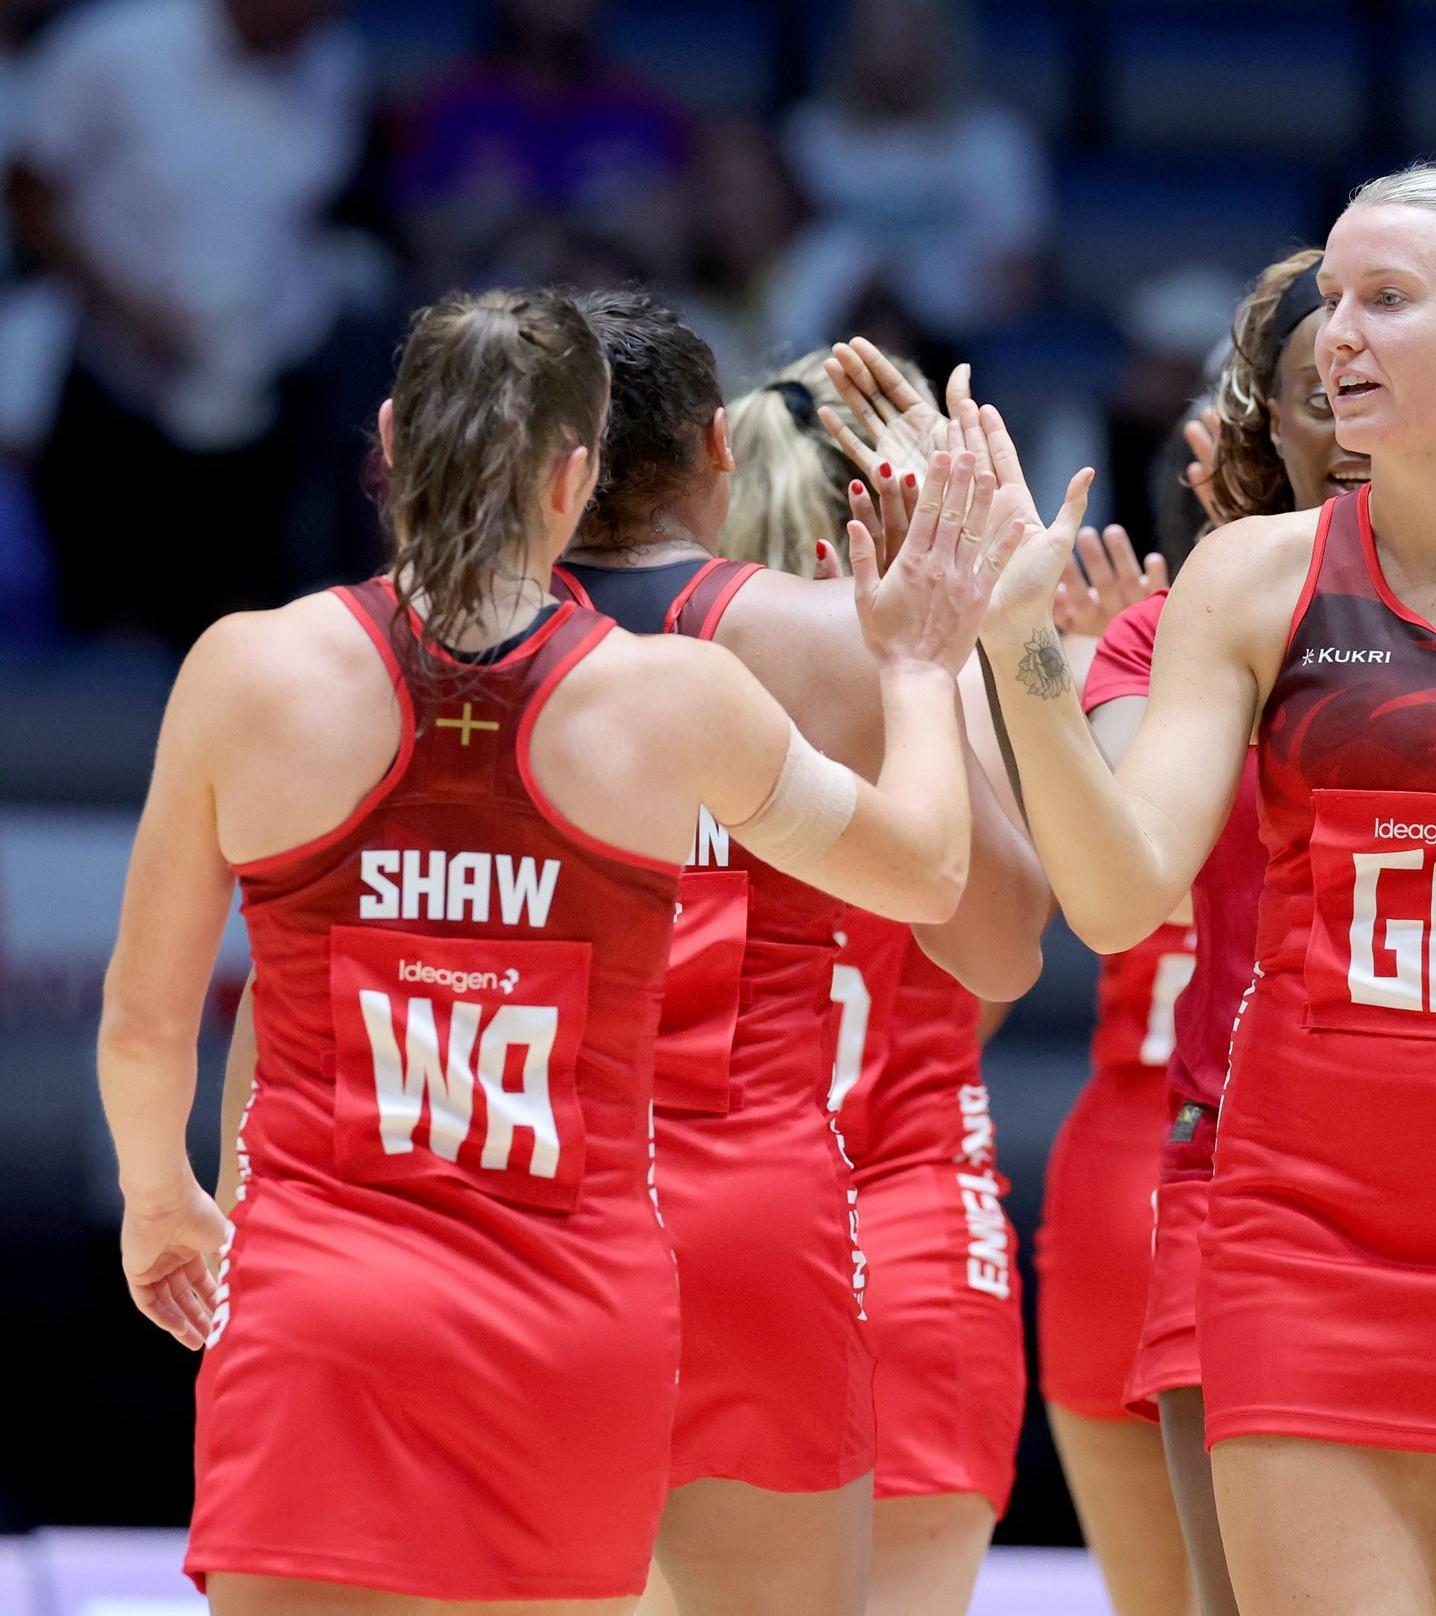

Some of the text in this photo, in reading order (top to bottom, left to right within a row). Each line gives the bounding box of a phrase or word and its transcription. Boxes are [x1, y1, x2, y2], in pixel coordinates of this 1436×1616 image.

[1317, 647, 1392, 664] KUKRI
[359, 849, 561, 928] SHAW
[399, 959, 498, 993] Ideagen
[358, 989, 559, 1179] WA
